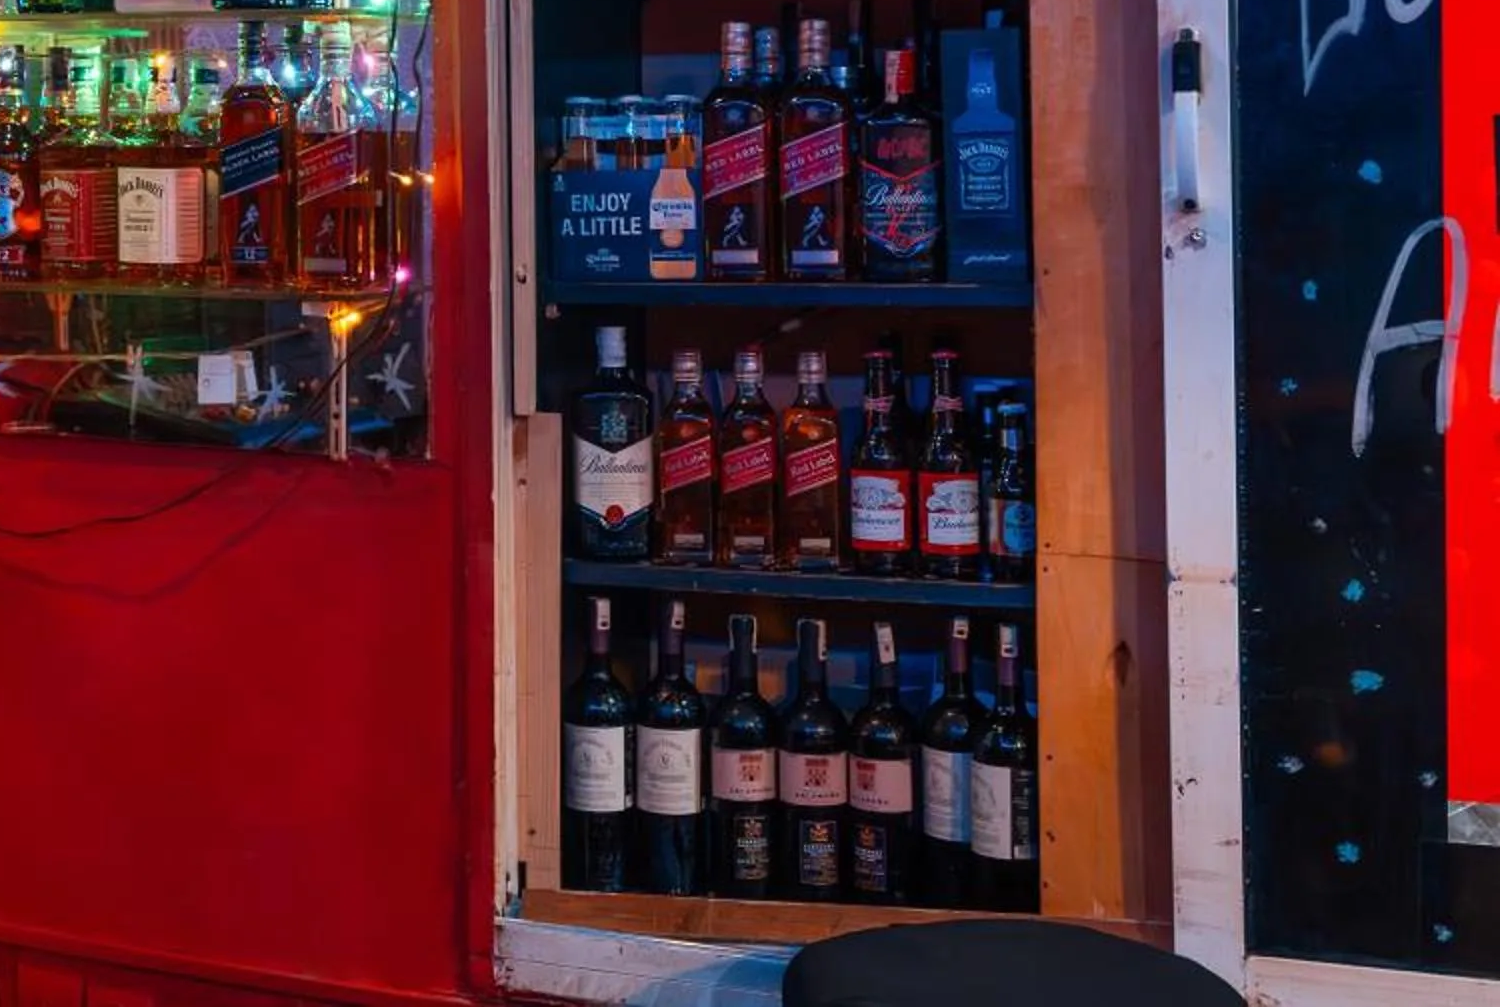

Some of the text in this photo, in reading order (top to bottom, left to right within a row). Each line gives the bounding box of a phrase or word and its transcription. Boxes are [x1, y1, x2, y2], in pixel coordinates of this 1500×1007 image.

[729, 144, 764, 163] LABEL
[806, 142, 843, 162] LABEL
[571, 193, 631, 213] ENJOY
[561, 216, 643, 237] A LITTLE
[809, 452, 837, 471] Label
